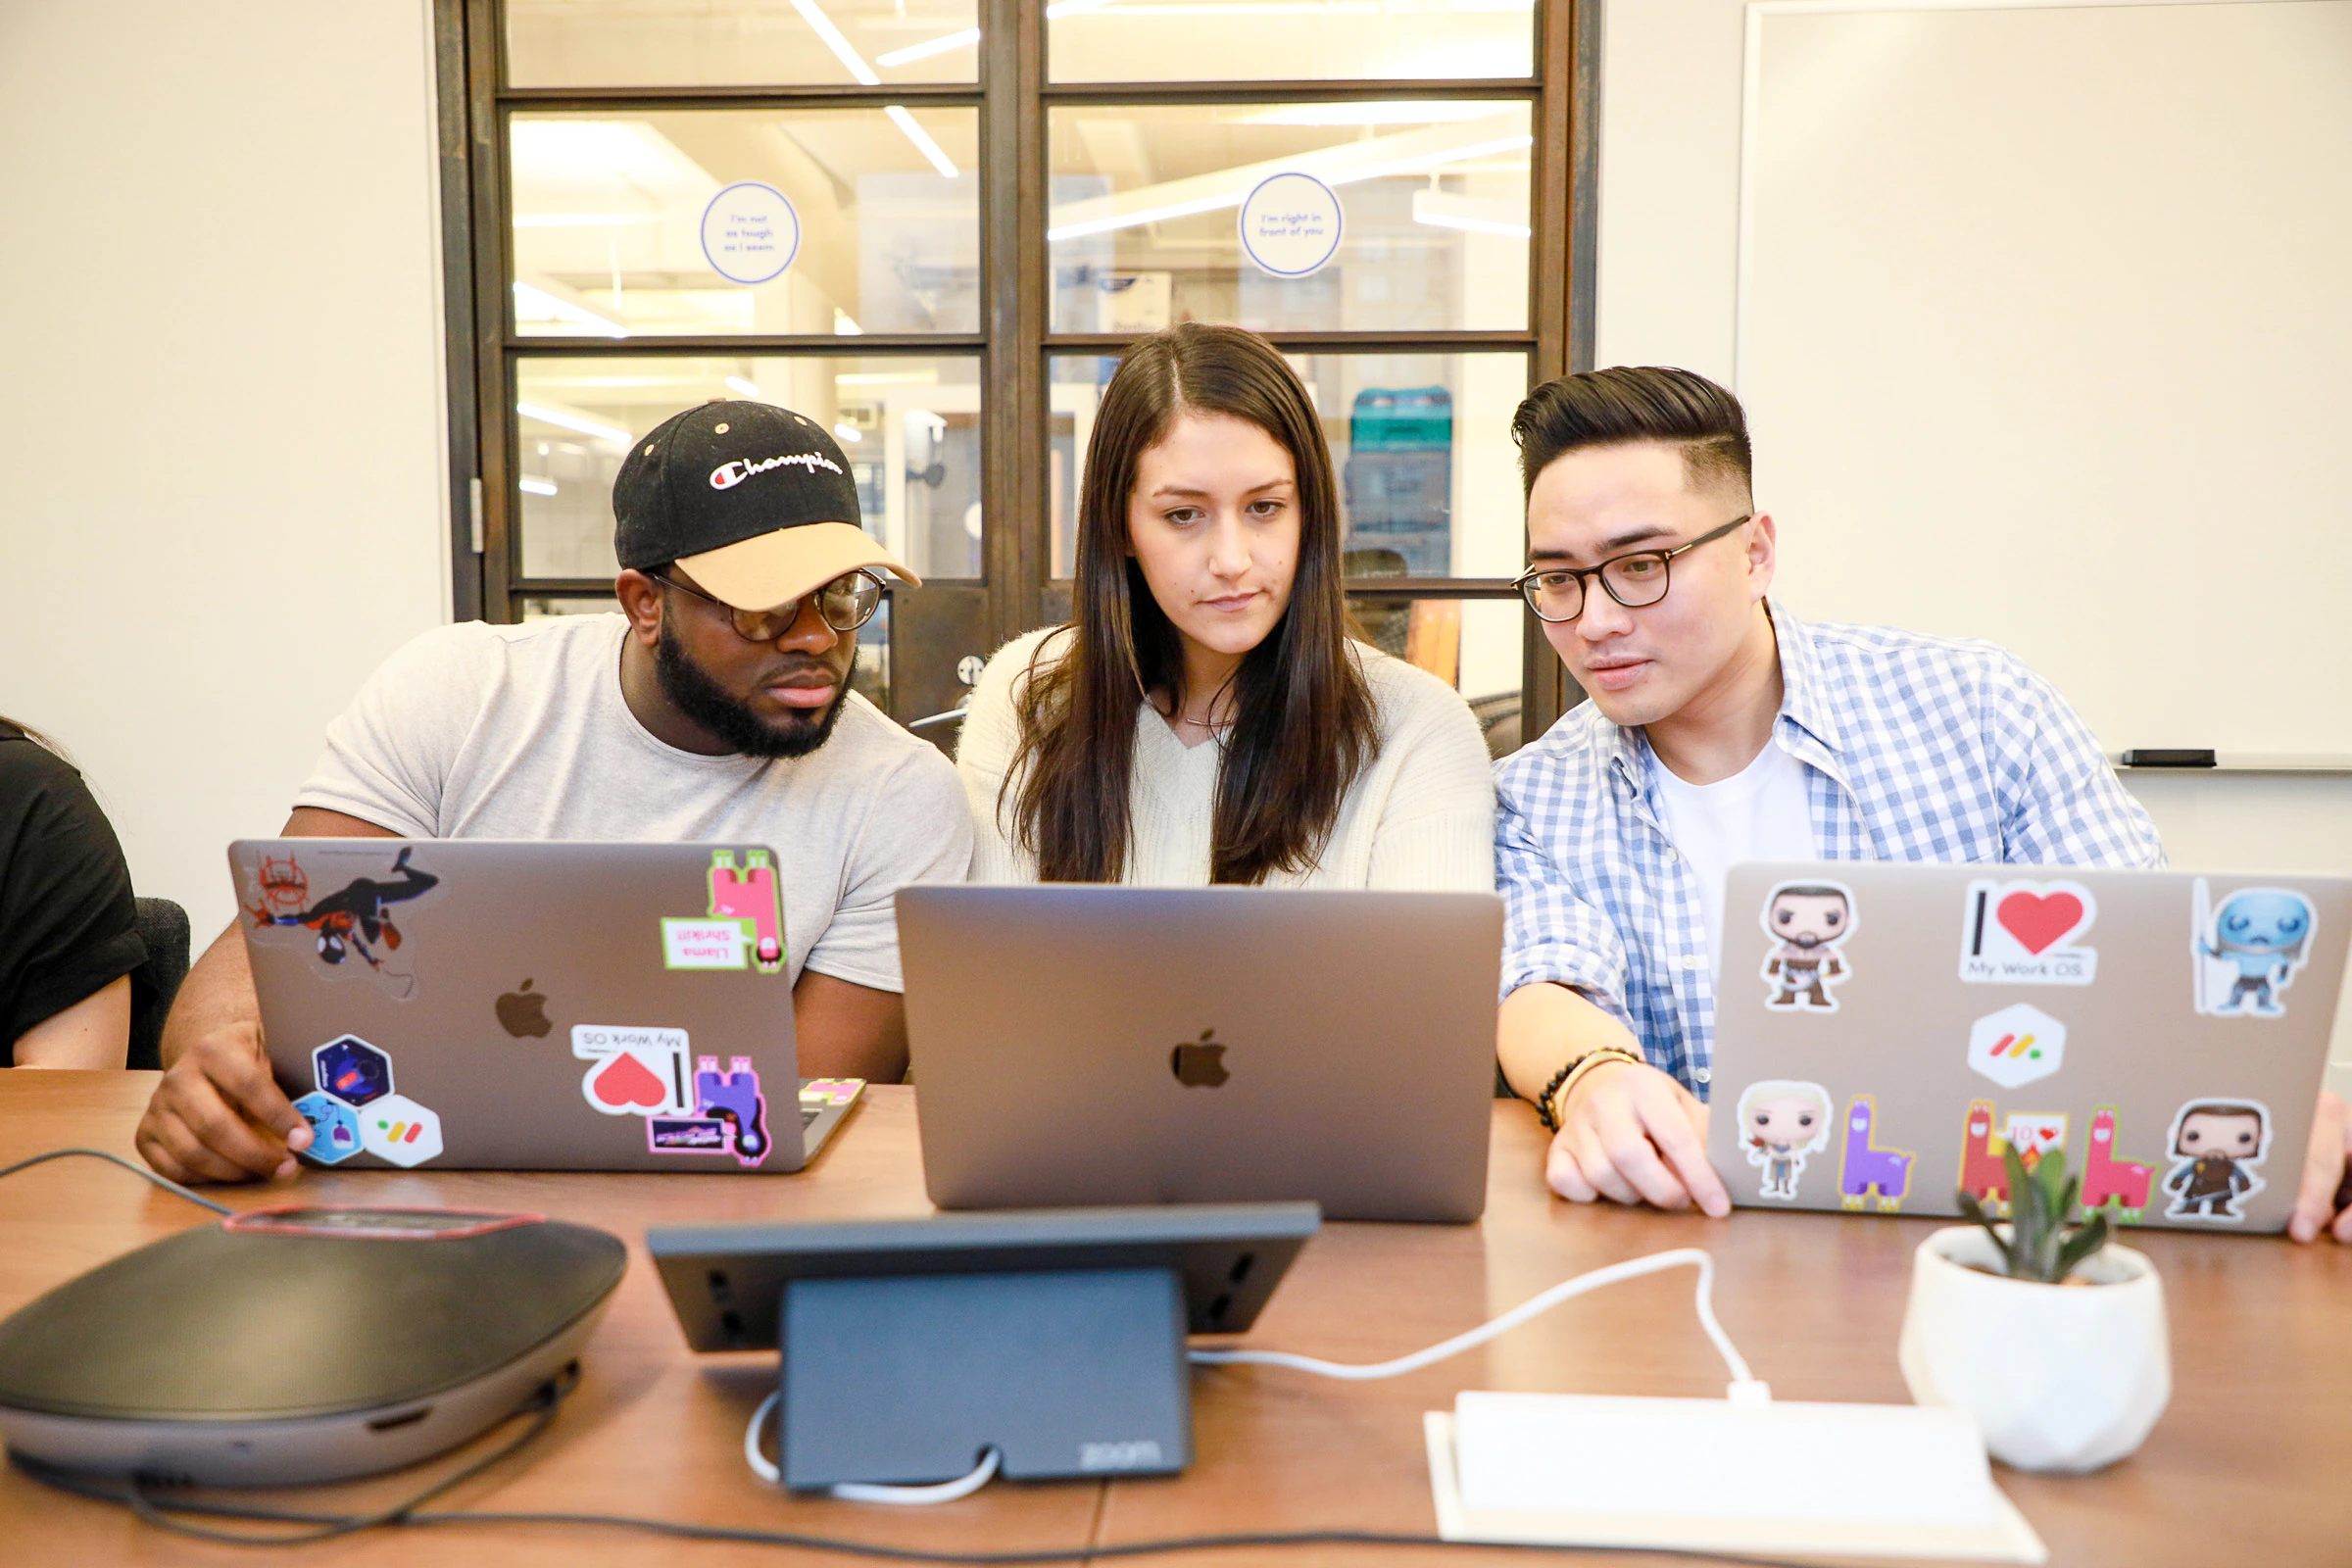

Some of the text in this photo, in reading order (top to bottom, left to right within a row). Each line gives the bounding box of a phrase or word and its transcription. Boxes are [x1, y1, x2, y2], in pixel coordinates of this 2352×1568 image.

[1281, 212, 1308, 225] right
[741, 227, 772, 240] tough
[1259, 226, 1287, 236] front
[1304, 227, 1324, 238] you
[710, 452, 843, 490] Champion
[683, 948, 729, 959] Llama
[1968, 960, 1995, 977] My
[2001, 961, 2047, 975] Work
[612, 1034, 653, 1047] Work
[658, 1032, 682, 1048] My
